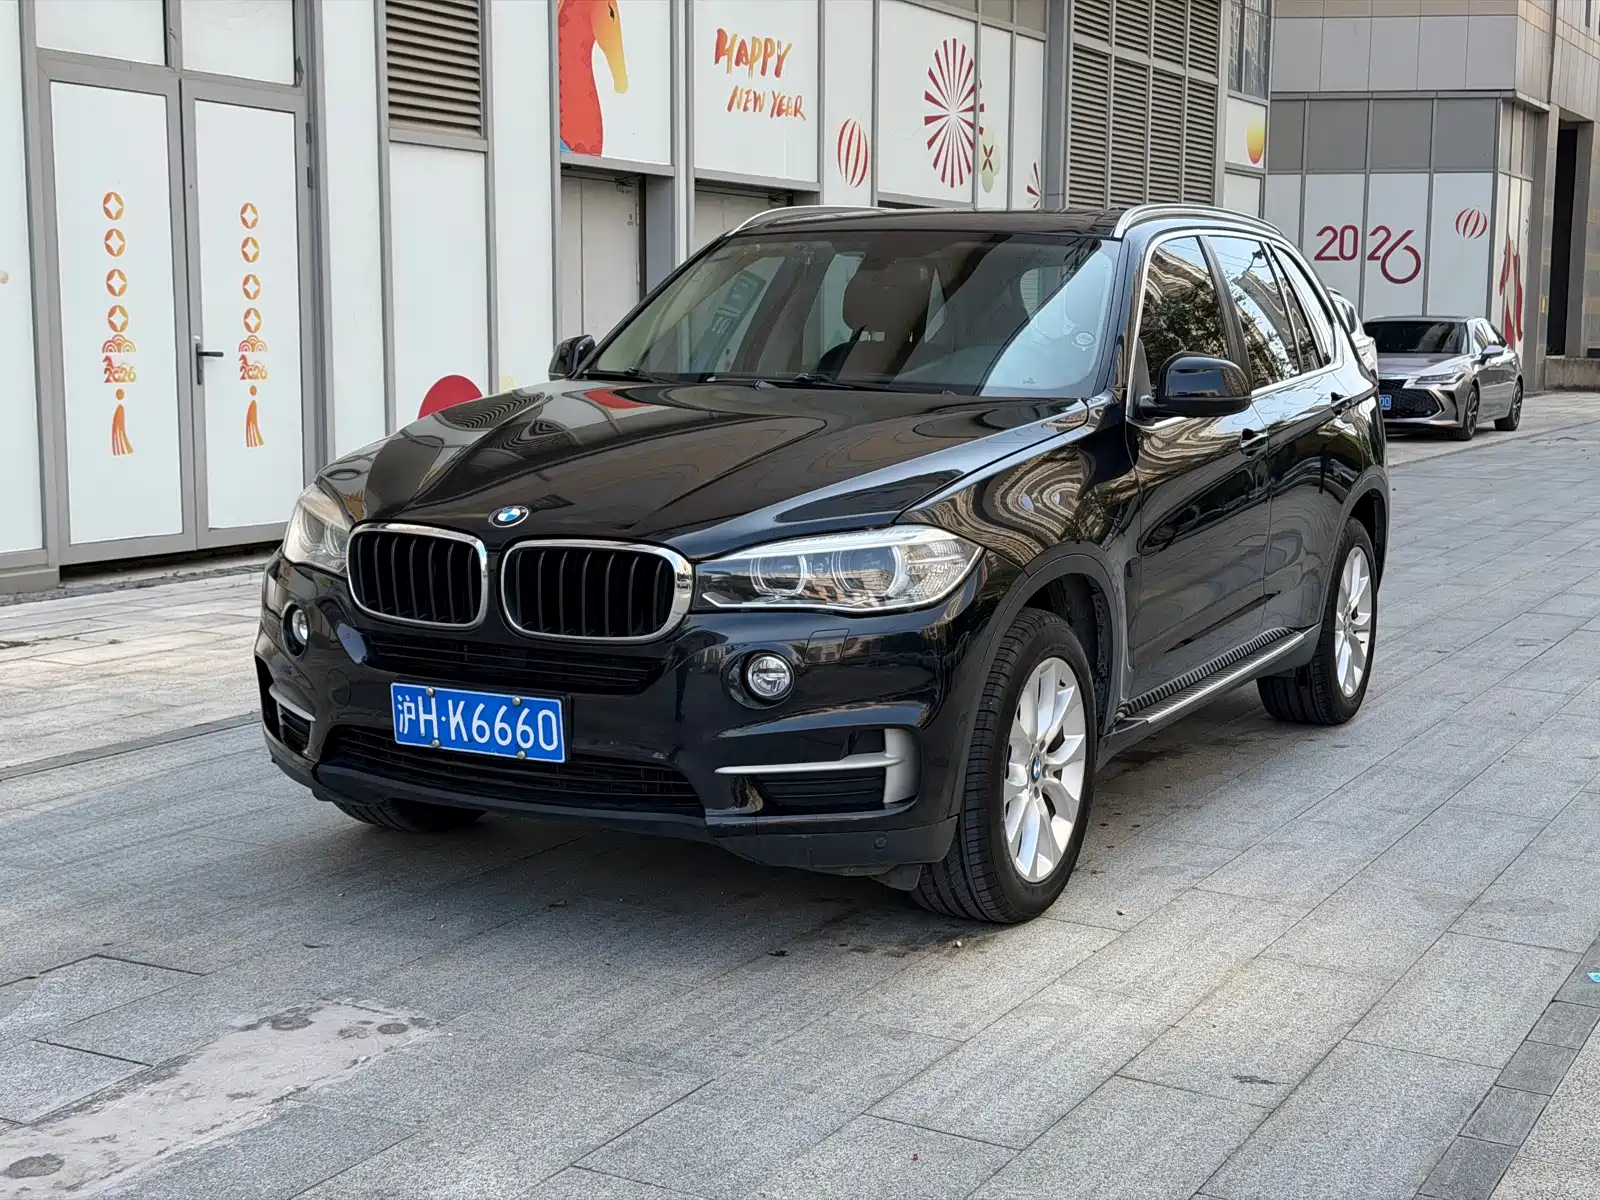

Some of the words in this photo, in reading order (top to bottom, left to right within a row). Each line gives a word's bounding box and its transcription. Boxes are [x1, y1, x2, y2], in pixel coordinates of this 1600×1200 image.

[714, 28, 793, 79] HAPPY
[726, 85, 766, 113] NEW
[769, 90, 807, 121] YEAR
[1314, 224, 1421, 284] 2026
[103, 365, 137, 383] 2026
[239, 365, 268, 380] 2026
